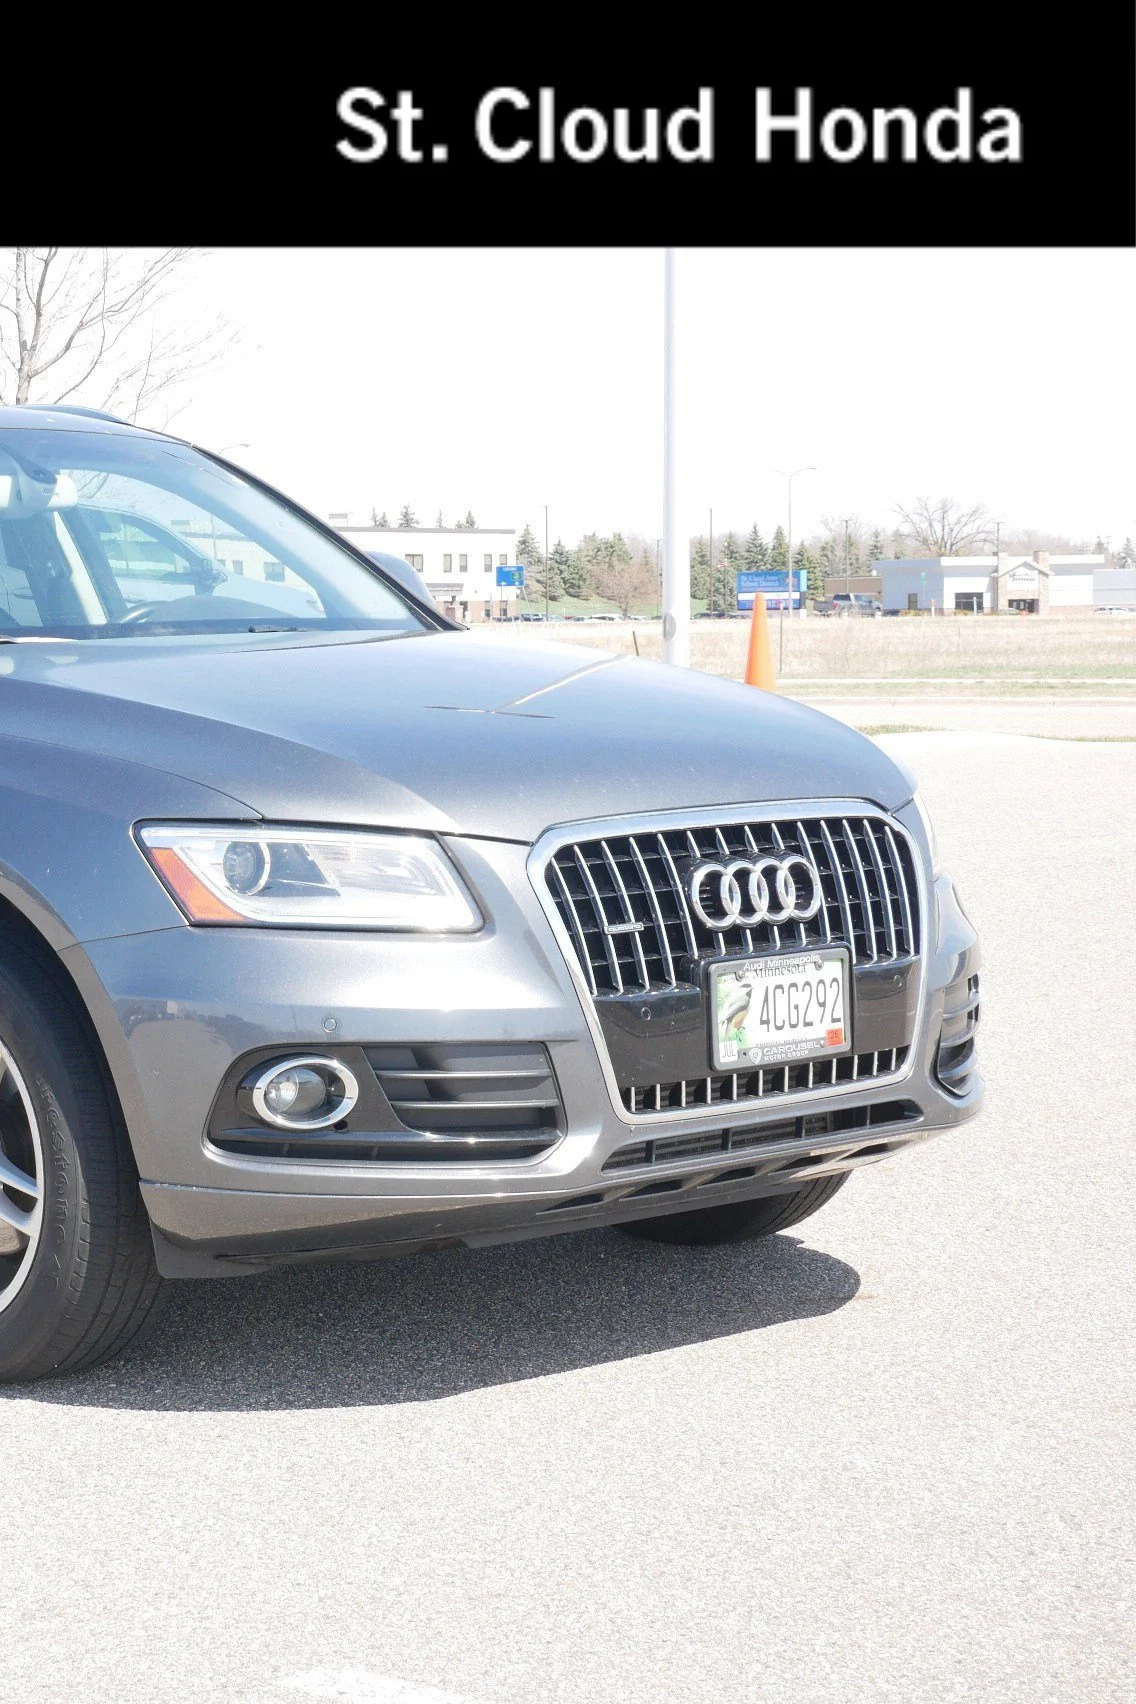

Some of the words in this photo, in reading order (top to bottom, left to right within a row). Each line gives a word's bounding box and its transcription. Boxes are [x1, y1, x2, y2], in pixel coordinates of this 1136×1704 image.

[743, 961, 765, 972] Audi
[767, 954, 821, 968] Minneapolis
[753, 963, 807, 979] Minnesota
[759, 977, 842, 1033] 4CG292
[763, 1041, 819, 1056] CAROUSEL
[764, 1053, 786, 1062] MOTOR
[788, 1050, 809, 1060] GROUP
